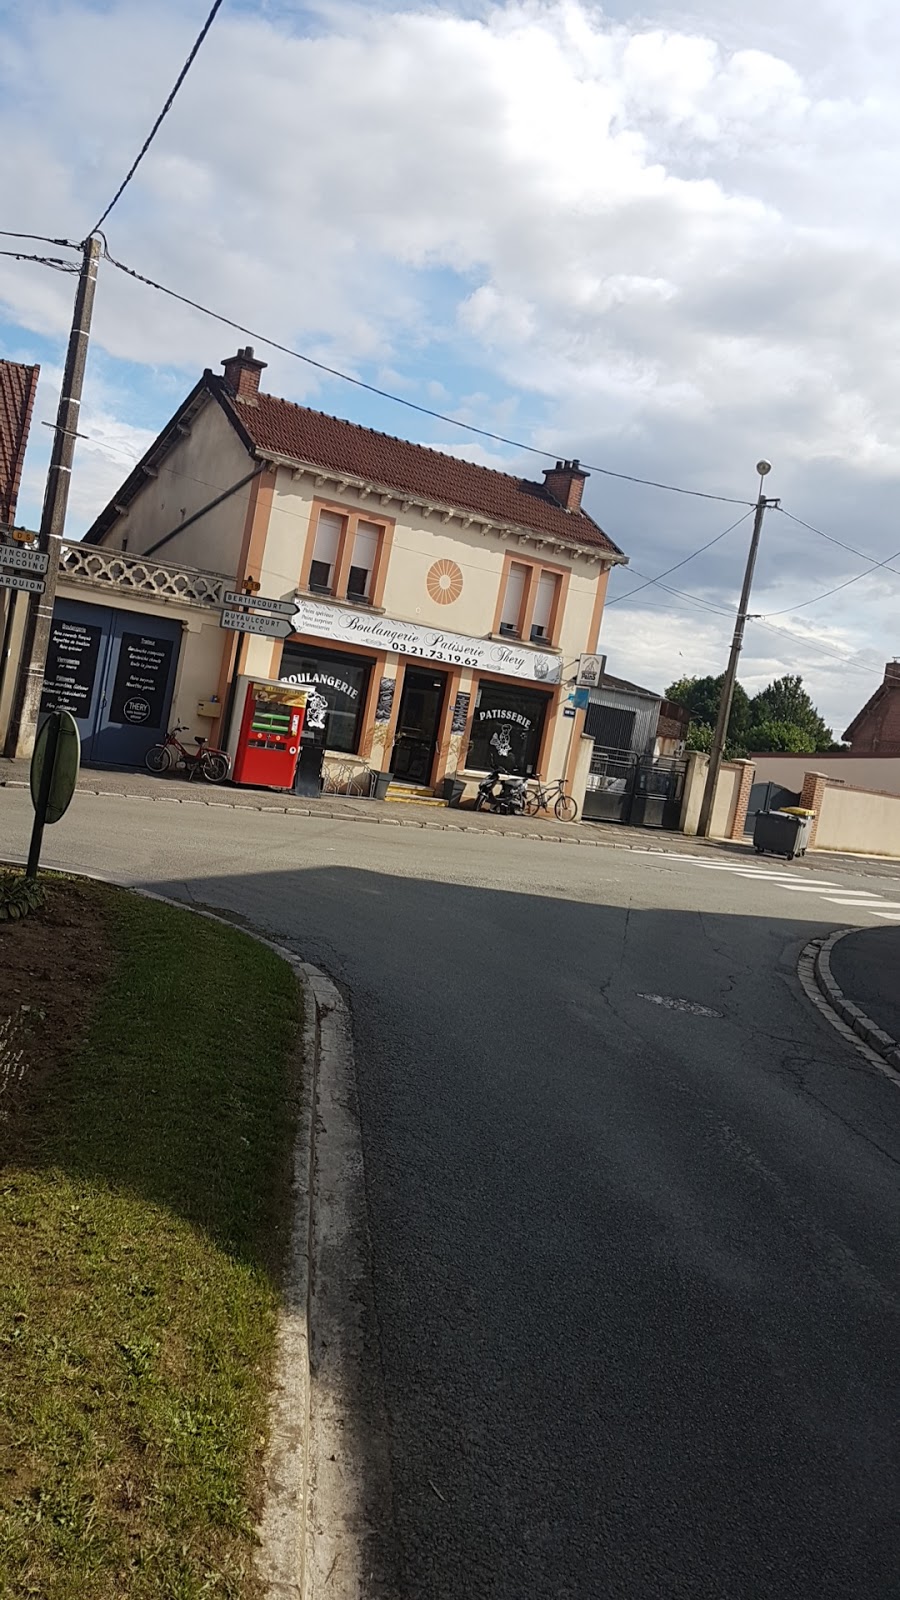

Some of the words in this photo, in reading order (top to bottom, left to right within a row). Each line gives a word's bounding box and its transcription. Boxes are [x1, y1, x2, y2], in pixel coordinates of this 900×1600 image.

[227, 594, 282, 610] BERTINCOURT
[223, 619, 246, 629] METZ
[225, 611, 280, 627] RUYAULCOURT
[338, 613, 420, 644] Boulangerie
[424, 631, 485, 657] Patisserie
[490, 643, 526, 670] Thery
[391, 641, 478, 667] 03.21.73.19.62
[129, 701, 149, 711] THERY
[479, 709, 532, 730] PATISSERIE
